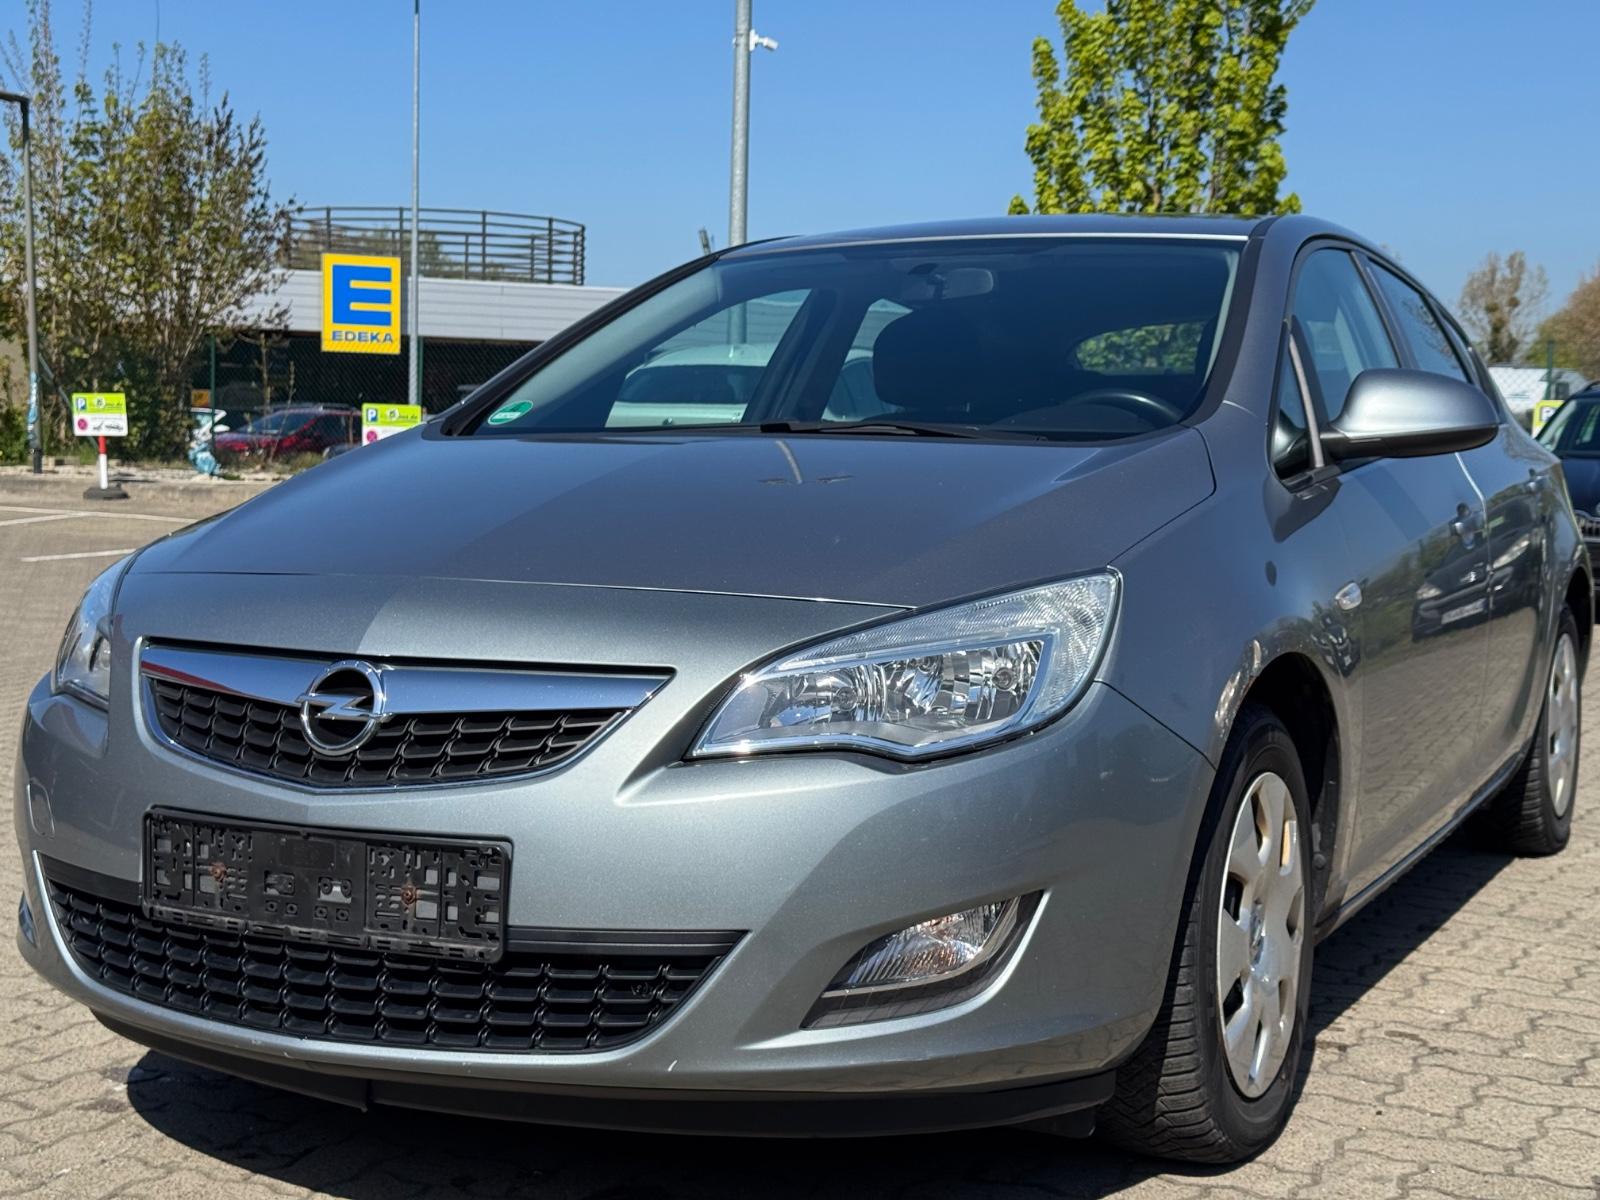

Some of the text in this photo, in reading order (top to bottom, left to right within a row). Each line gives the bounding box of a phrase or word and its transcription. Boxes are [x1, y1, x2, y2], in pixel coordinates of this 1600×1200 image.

[333, 265, 392, 326] E
[332, 330, 393, 343] EDEKA
[367, 408, 377, 422] P
